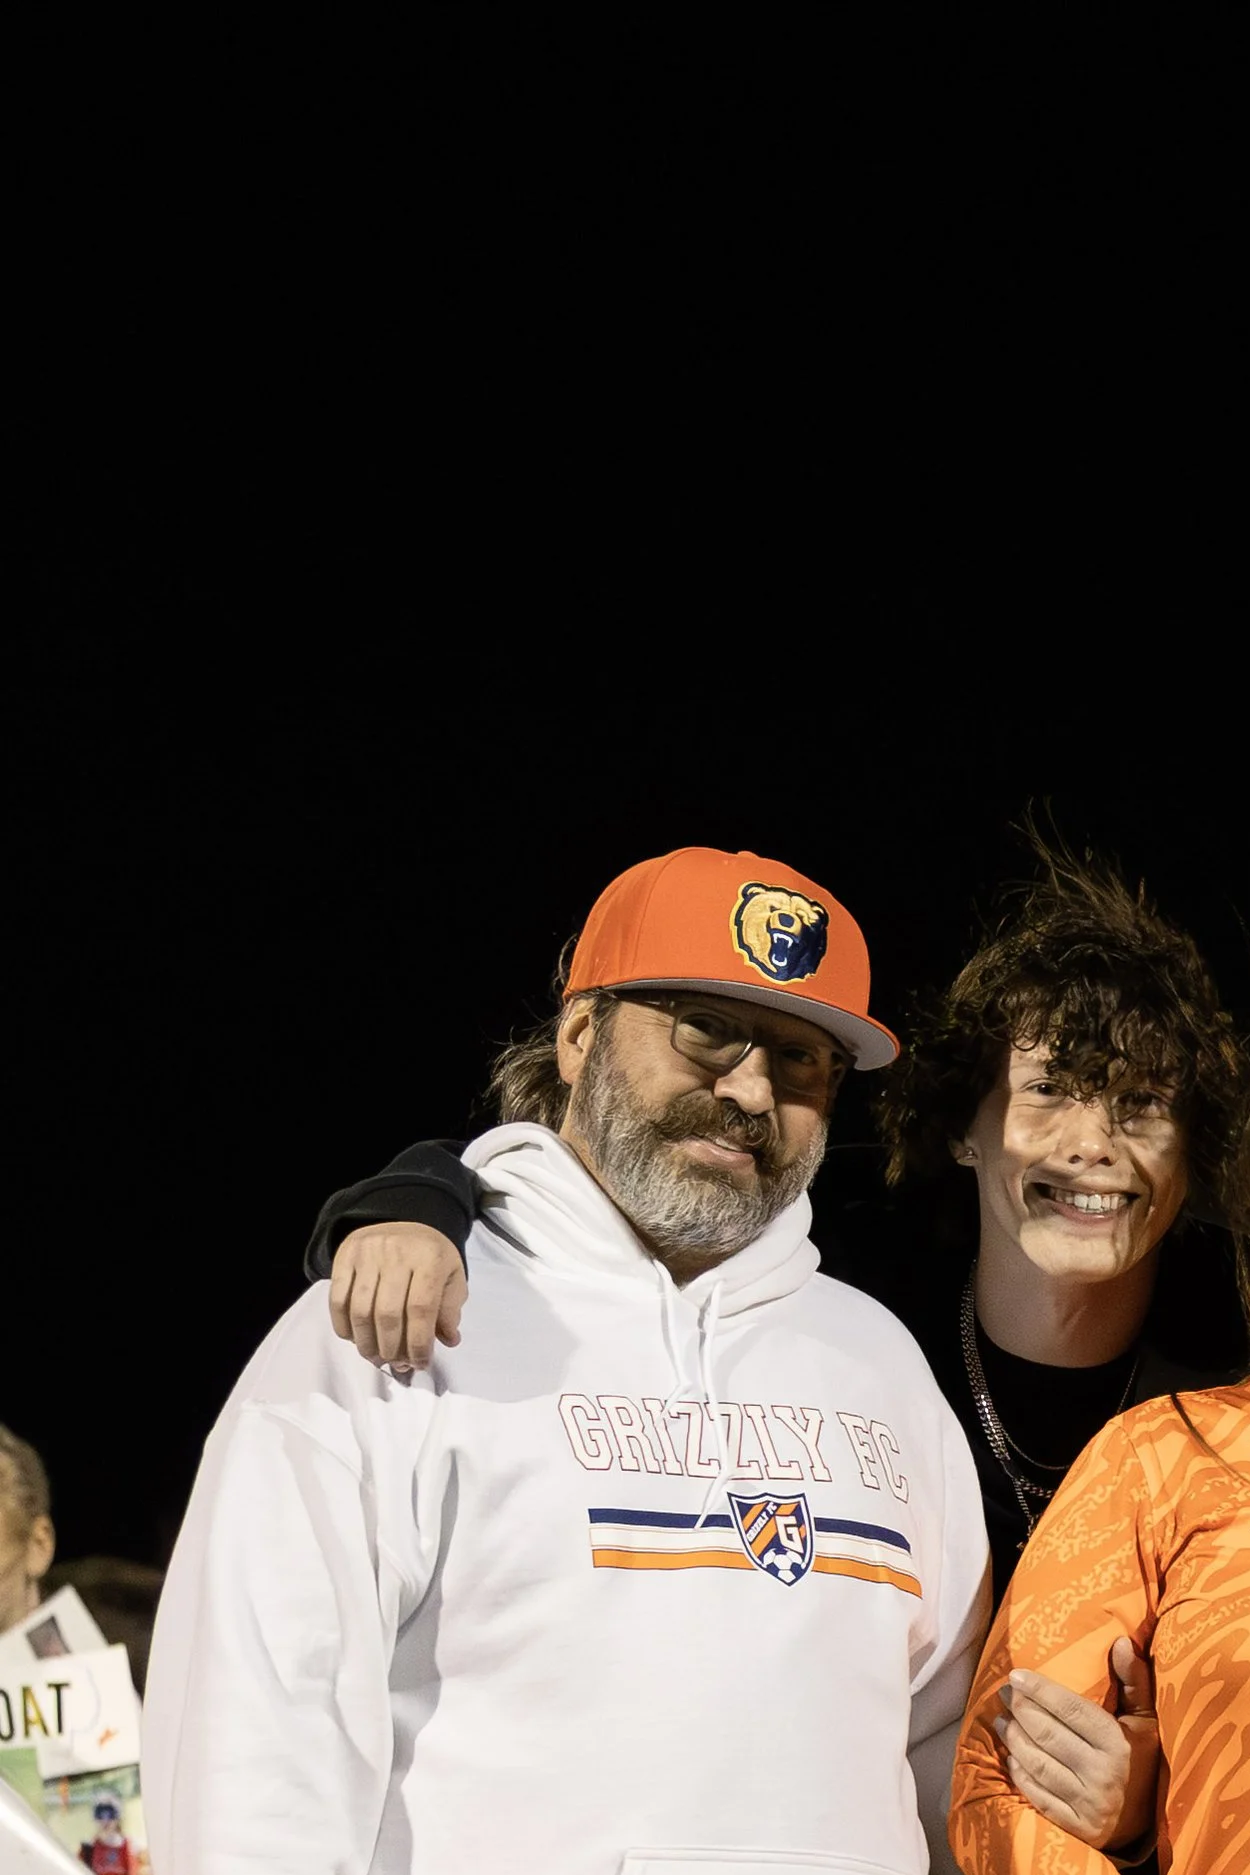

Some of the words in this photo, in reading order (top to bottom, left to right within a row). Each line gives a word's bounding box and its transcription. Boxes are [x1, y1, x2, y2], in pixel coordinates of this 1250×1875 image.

[558, 1393, 832, 1482] GRIZZLY
[836, 1411, 909, 1503] FC
[775, 1515, 804, 1555] G
